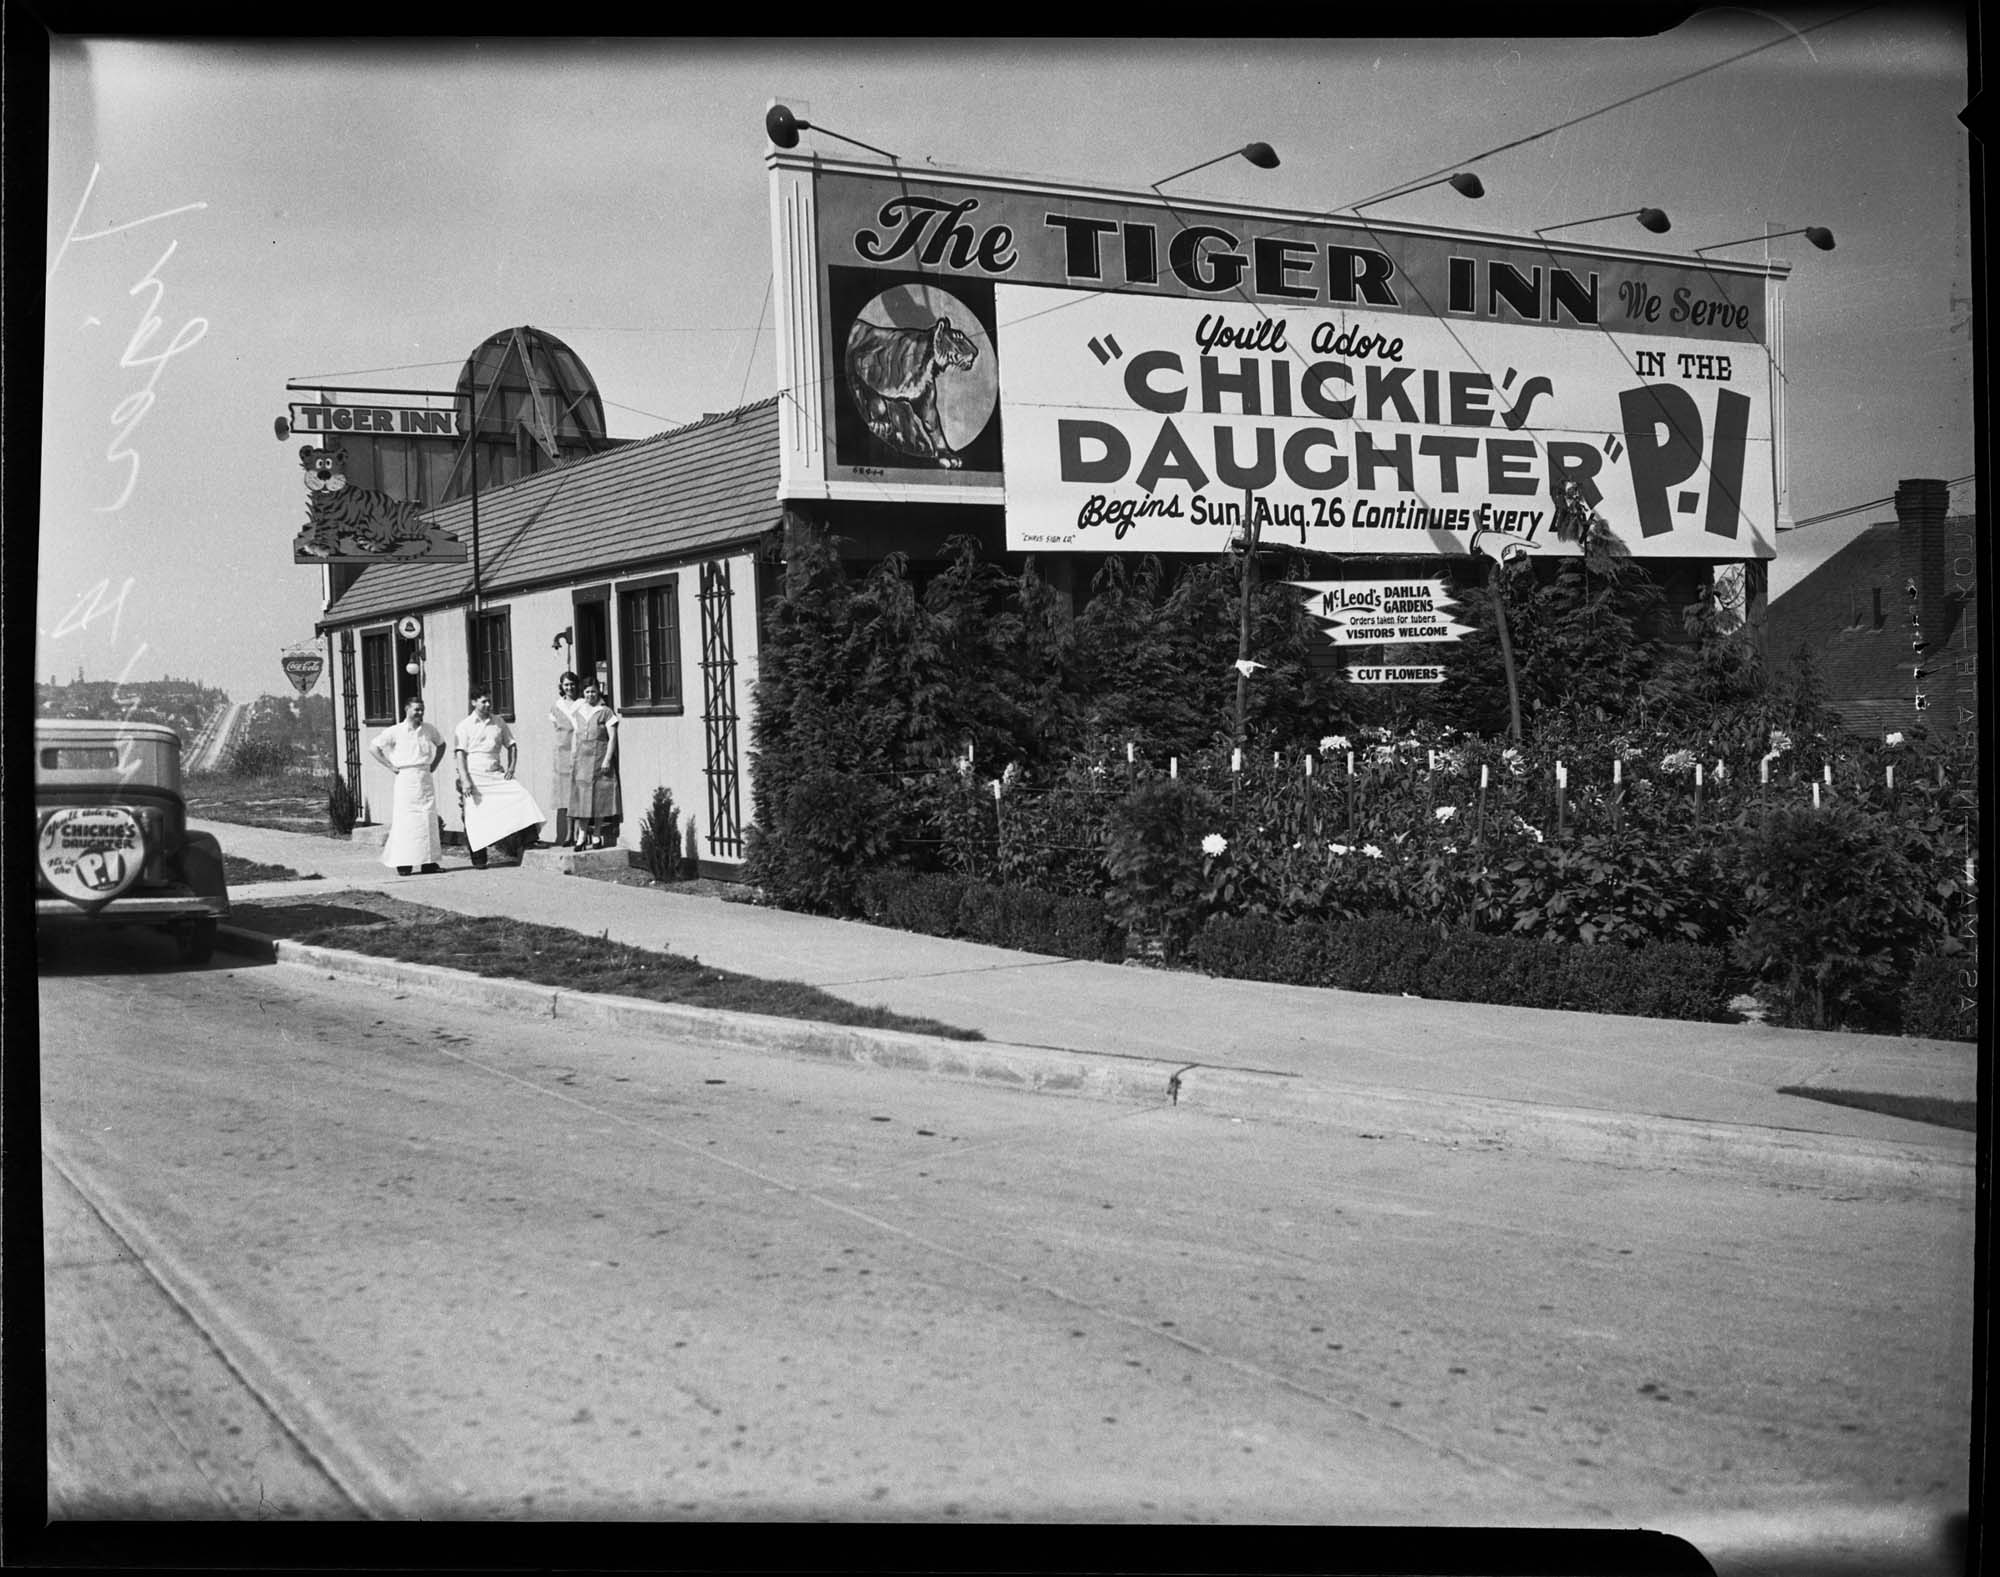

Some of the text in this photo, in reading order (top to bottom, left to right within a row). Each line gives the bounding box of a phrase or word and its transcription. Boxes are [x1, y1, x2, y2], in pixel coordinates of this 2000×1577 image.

[854, 196, 1600, 326] The TIGER INN
[1619, 280, 1749, 330] We Serve
[1196, 314, 1288, 355] You'll
[1635, 351, 1732, 381] IN THE
[301, 406, 452, 434] TIGER INN
[1077, 494, 1184, 540] Begins
[1313, 497, 1346, 528] 26
[1352, 499, 1470, 531] Continues
[1480, 503, 1543, 542] Every
[1384, 586, 1432, 598] DAHLIA
[1350, 614, 1437, 626] Orders taken for tubers
[1384, 600, 1434, 613] GARDENS
[1346, 626, 1448, 639] VISITORS WELCOME
[1357, 668, 1439, 680] CUT FLOWERS
